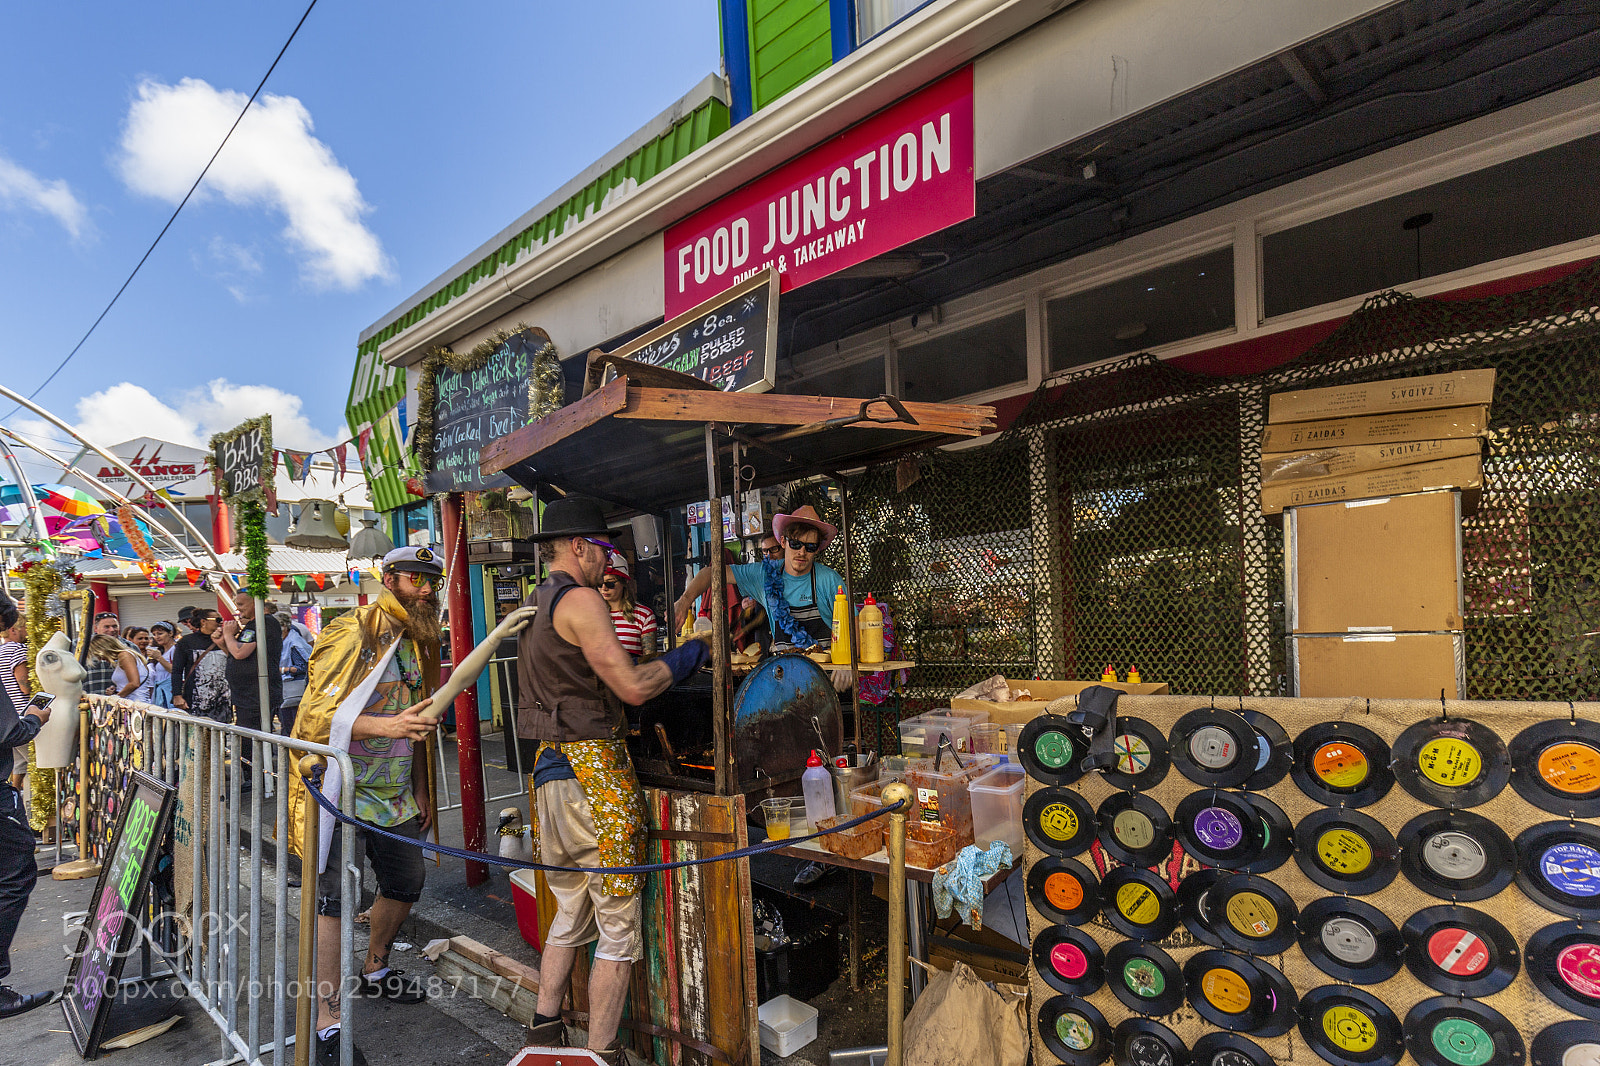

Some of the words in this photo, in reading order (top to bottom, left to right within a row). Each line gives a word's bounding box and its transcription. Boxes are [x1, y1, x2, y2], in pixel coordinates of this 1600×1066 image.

[678, 217, 750, 293] FOOD
[763, 112, 951, 254] JUNCTION
[778, 254, 787, 273] &
[793, 218, 866, 267] TAKEAWAY
[662, 346, 700, 373] EGAN
[701, 326, 745, 353] PULLED
[700, 337, 745, 364] PORK
[709, 350, 754, 382] BEEF
[1391, 386, 1434, 399] ZAIDA'S
[1307, 428, 1345, 440] ZAIDA'S
[223, 428, 264, 473] BAR
[1380, 442, 1422, 458] ZAIDA'S
[234, 465, 259, 493] BBQ
[1308, 485, 1346, 498] ZAIDA'S
[1552, 844, 1572, 853] TOP
[1572, 844, 1593, 857] RANK
